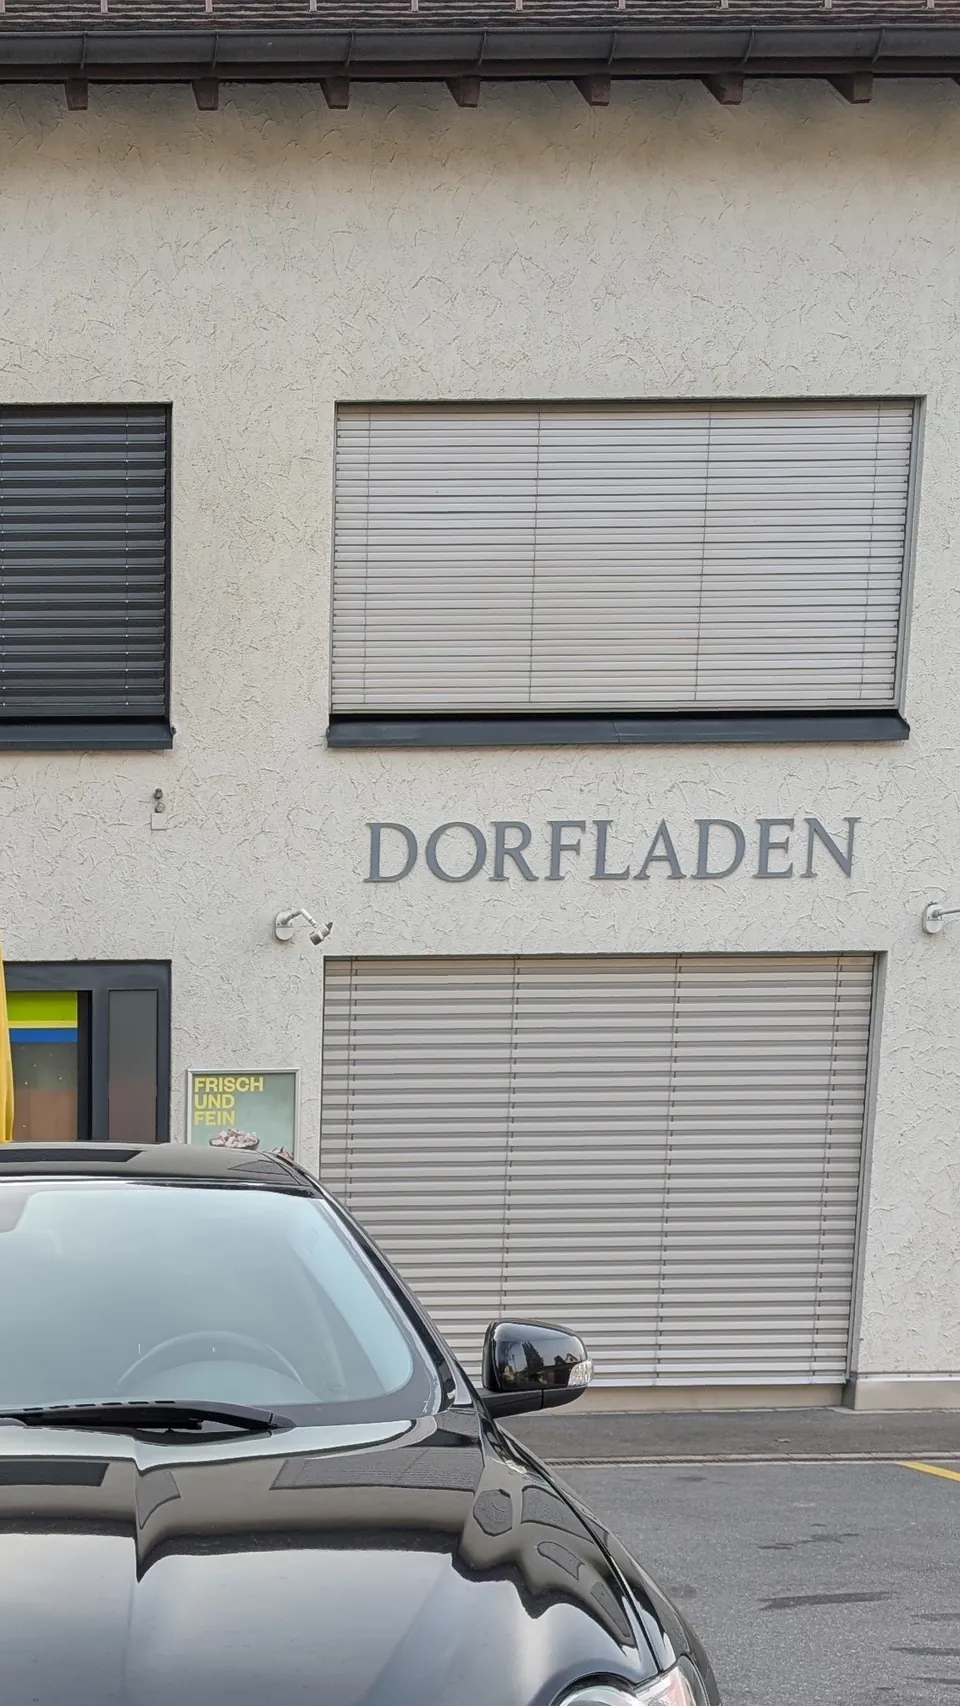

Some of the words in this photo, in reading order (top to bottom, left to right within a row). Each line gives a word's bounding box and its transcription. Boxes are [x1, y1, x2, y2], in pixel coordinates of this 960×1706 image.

[362, 815, 863, 883] DORFLADEN
[193, 1076, 265, 1094] FRISCH
[193, 1093, 237, 1110] UND
[193, 1110, 237, 1127] FEIN
